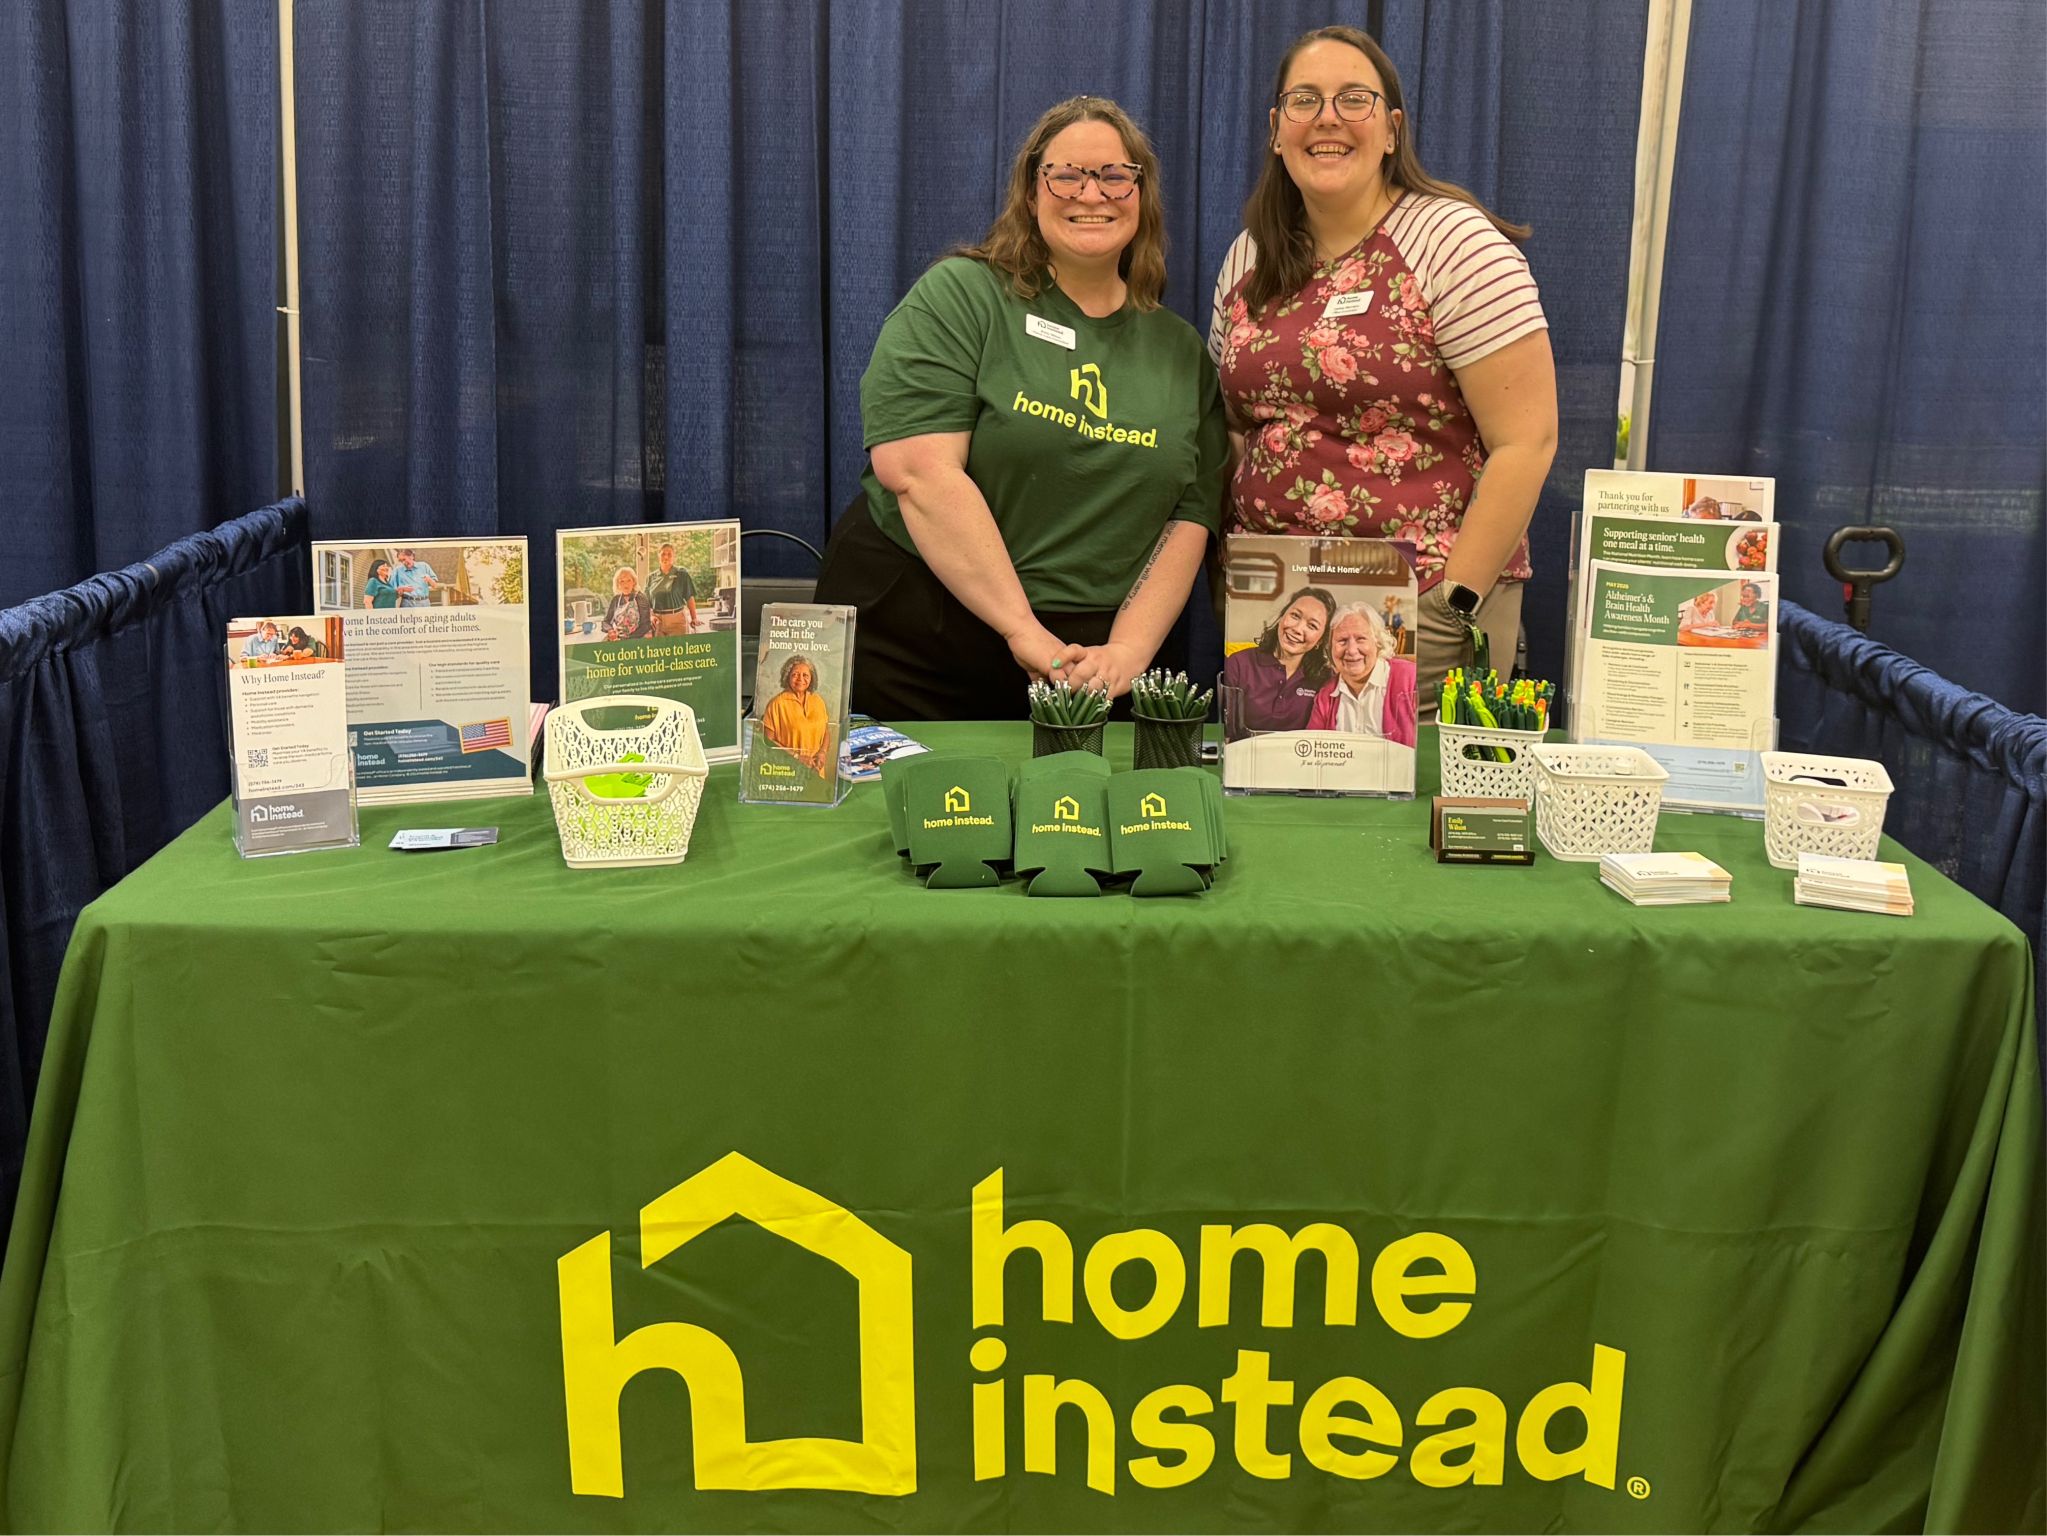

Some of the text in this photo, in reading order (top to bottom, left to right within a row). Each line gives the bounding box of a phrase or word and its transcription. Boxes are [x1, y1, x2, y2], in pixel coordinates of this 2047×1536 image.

[1013, 391, 1076, 428] home
[1599, 491, 1653, 502] Thank you for
[1598, 503, 1639, 512] partnering
[1641, 503, 1658, 511] with
[1604, 528, 1705, 544] Supporting seniors' health
[1619, 541, 1637, 550] meal
[1655, 543, 1674, 552] time.
[1606, 590, 1654, 603] Alzheimer's &
[1606, 600, 1650, 613] Brain Health
[367, 615, 397, 625] Instead
[400, 614, 422, 625] helps
[424, 614, 448, 624] aging
[450, 613, 476, 621] adults
[771, 616, 787, 626] The
[808, 620, 822, 629] you
[1605, 610, 1669, 624] Awareness Month
[355, 628, 363, 636] in
[366, 626, 379, 635] the
[382, 625, 416, 634] comfort
[418, 624, 427, 633] of
[429, 624, 448, 632] their
[452, 623, 480, 632] homes.
[770, 628, 815, 639] need in the
[770, 639, 830, 652] home you love.
[594, 642, 711, 663] You don't have to leave
[586, 658, 718, 679] home for world-class care.
[241, 670, 325, 685] Why Home Instead?
[1314, 740, 1345, 749] Home
[1314, 750, 1353, 758] Instead
[269, 805, 295, 813] home
[924, 819, 953, 829] home
[1032, 824, 1060, 834] home
[1121, 822, 1150, 835] home
[972, 1166, 1476, 1340] home
